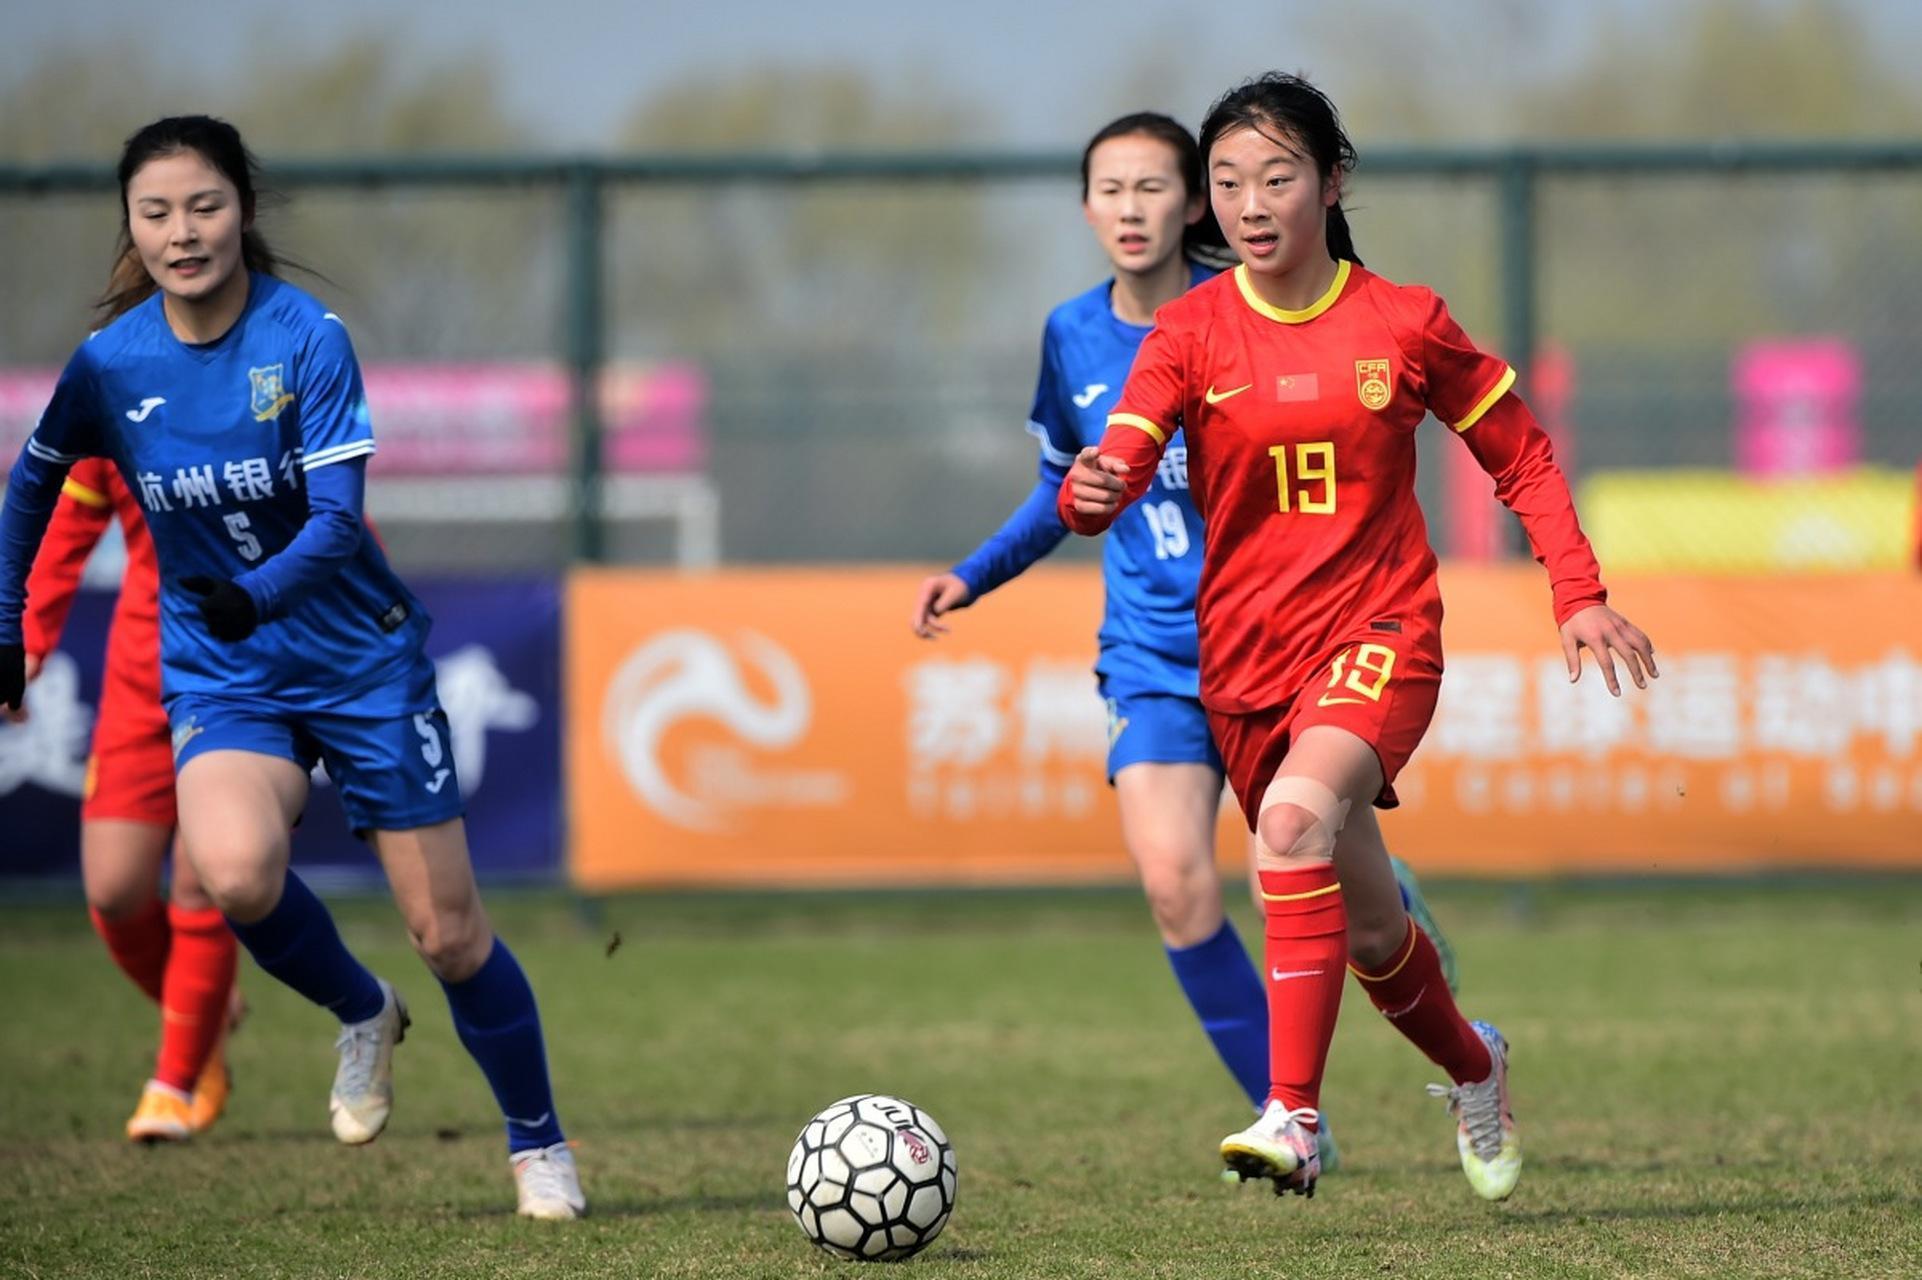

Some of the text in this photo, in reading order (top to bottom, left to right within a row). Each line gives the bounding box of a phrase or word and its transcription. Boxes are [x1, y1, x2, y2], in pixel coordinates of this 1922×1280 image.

[1359, 363, 1387, 373] CFA
[1268, 441, 1337, 514] 19
[223, 511, 263, 562] 5
[1141, 499, 1190, 560] 19
[1327, 643, 1397, 702] 19
[413, 710, 443, 768] 5
